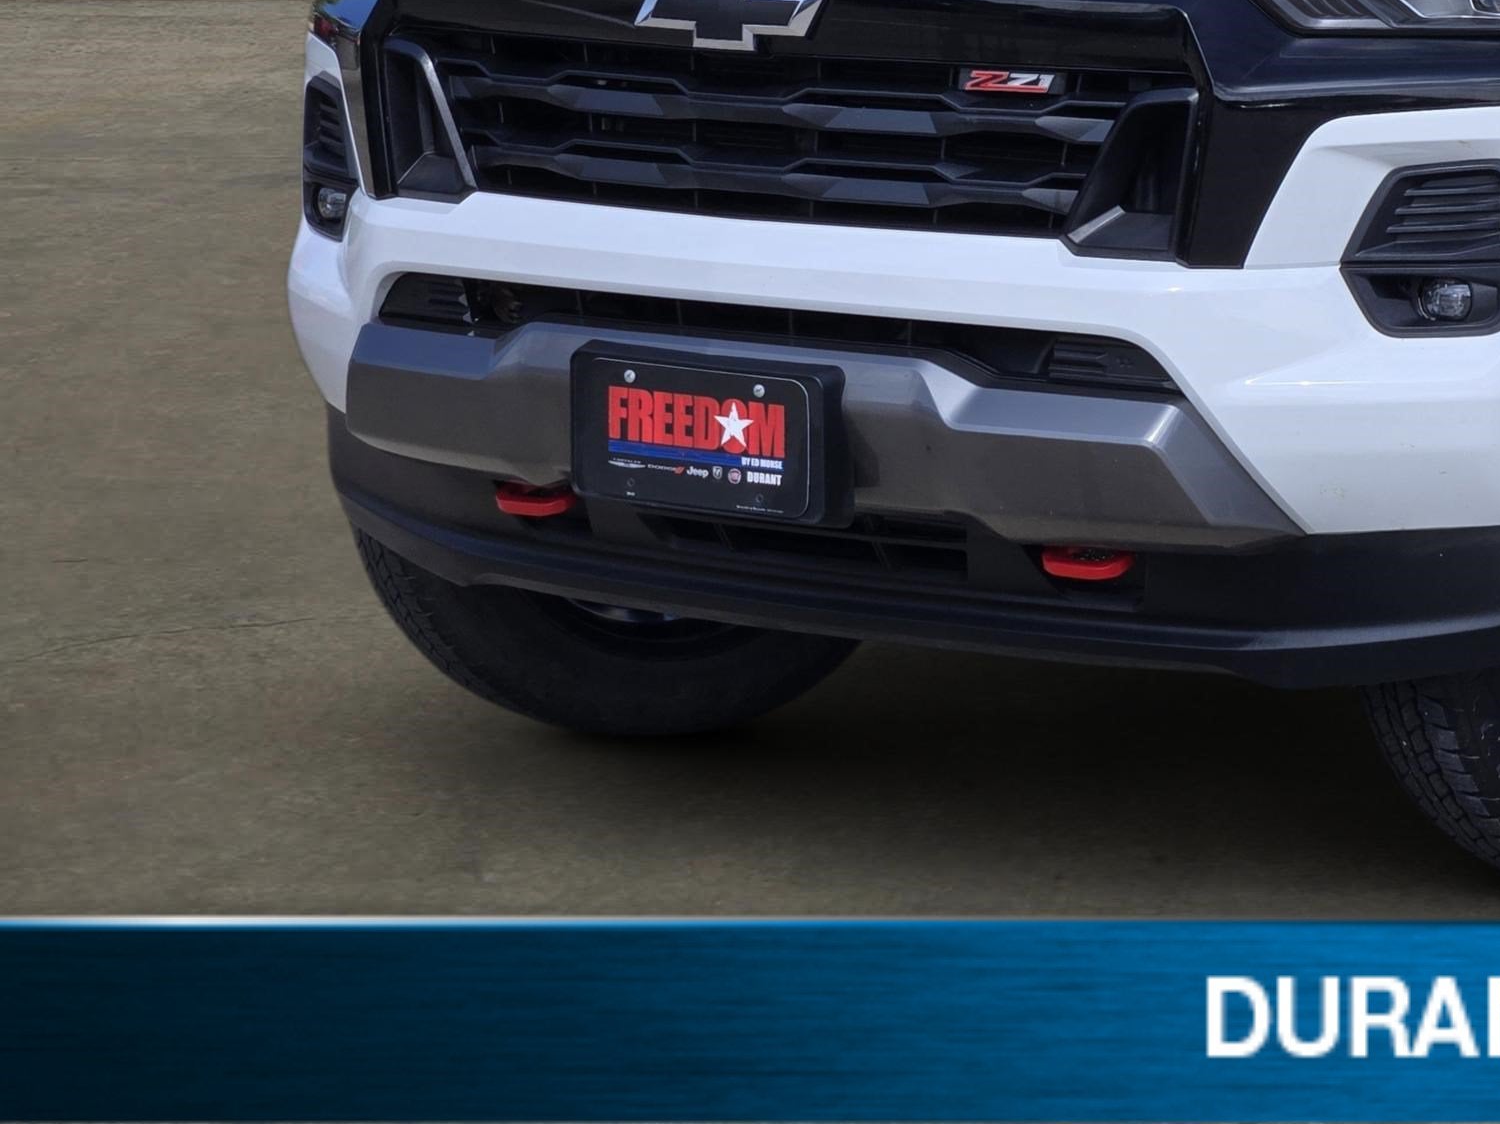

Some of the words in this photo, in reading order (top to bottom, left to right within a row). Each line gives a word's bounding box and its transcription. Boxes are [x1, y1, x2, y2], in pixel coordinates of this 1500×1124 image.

[965, 70, 1055, 94] Z71
[607, 385, 785, 459] FREEDOM
[751, 457, 760, 467] ED
[760, 458, 783, 470] MORSE
[686, 466, 709, 479] Jeep
[746, 471, 783, 486] DURANT
